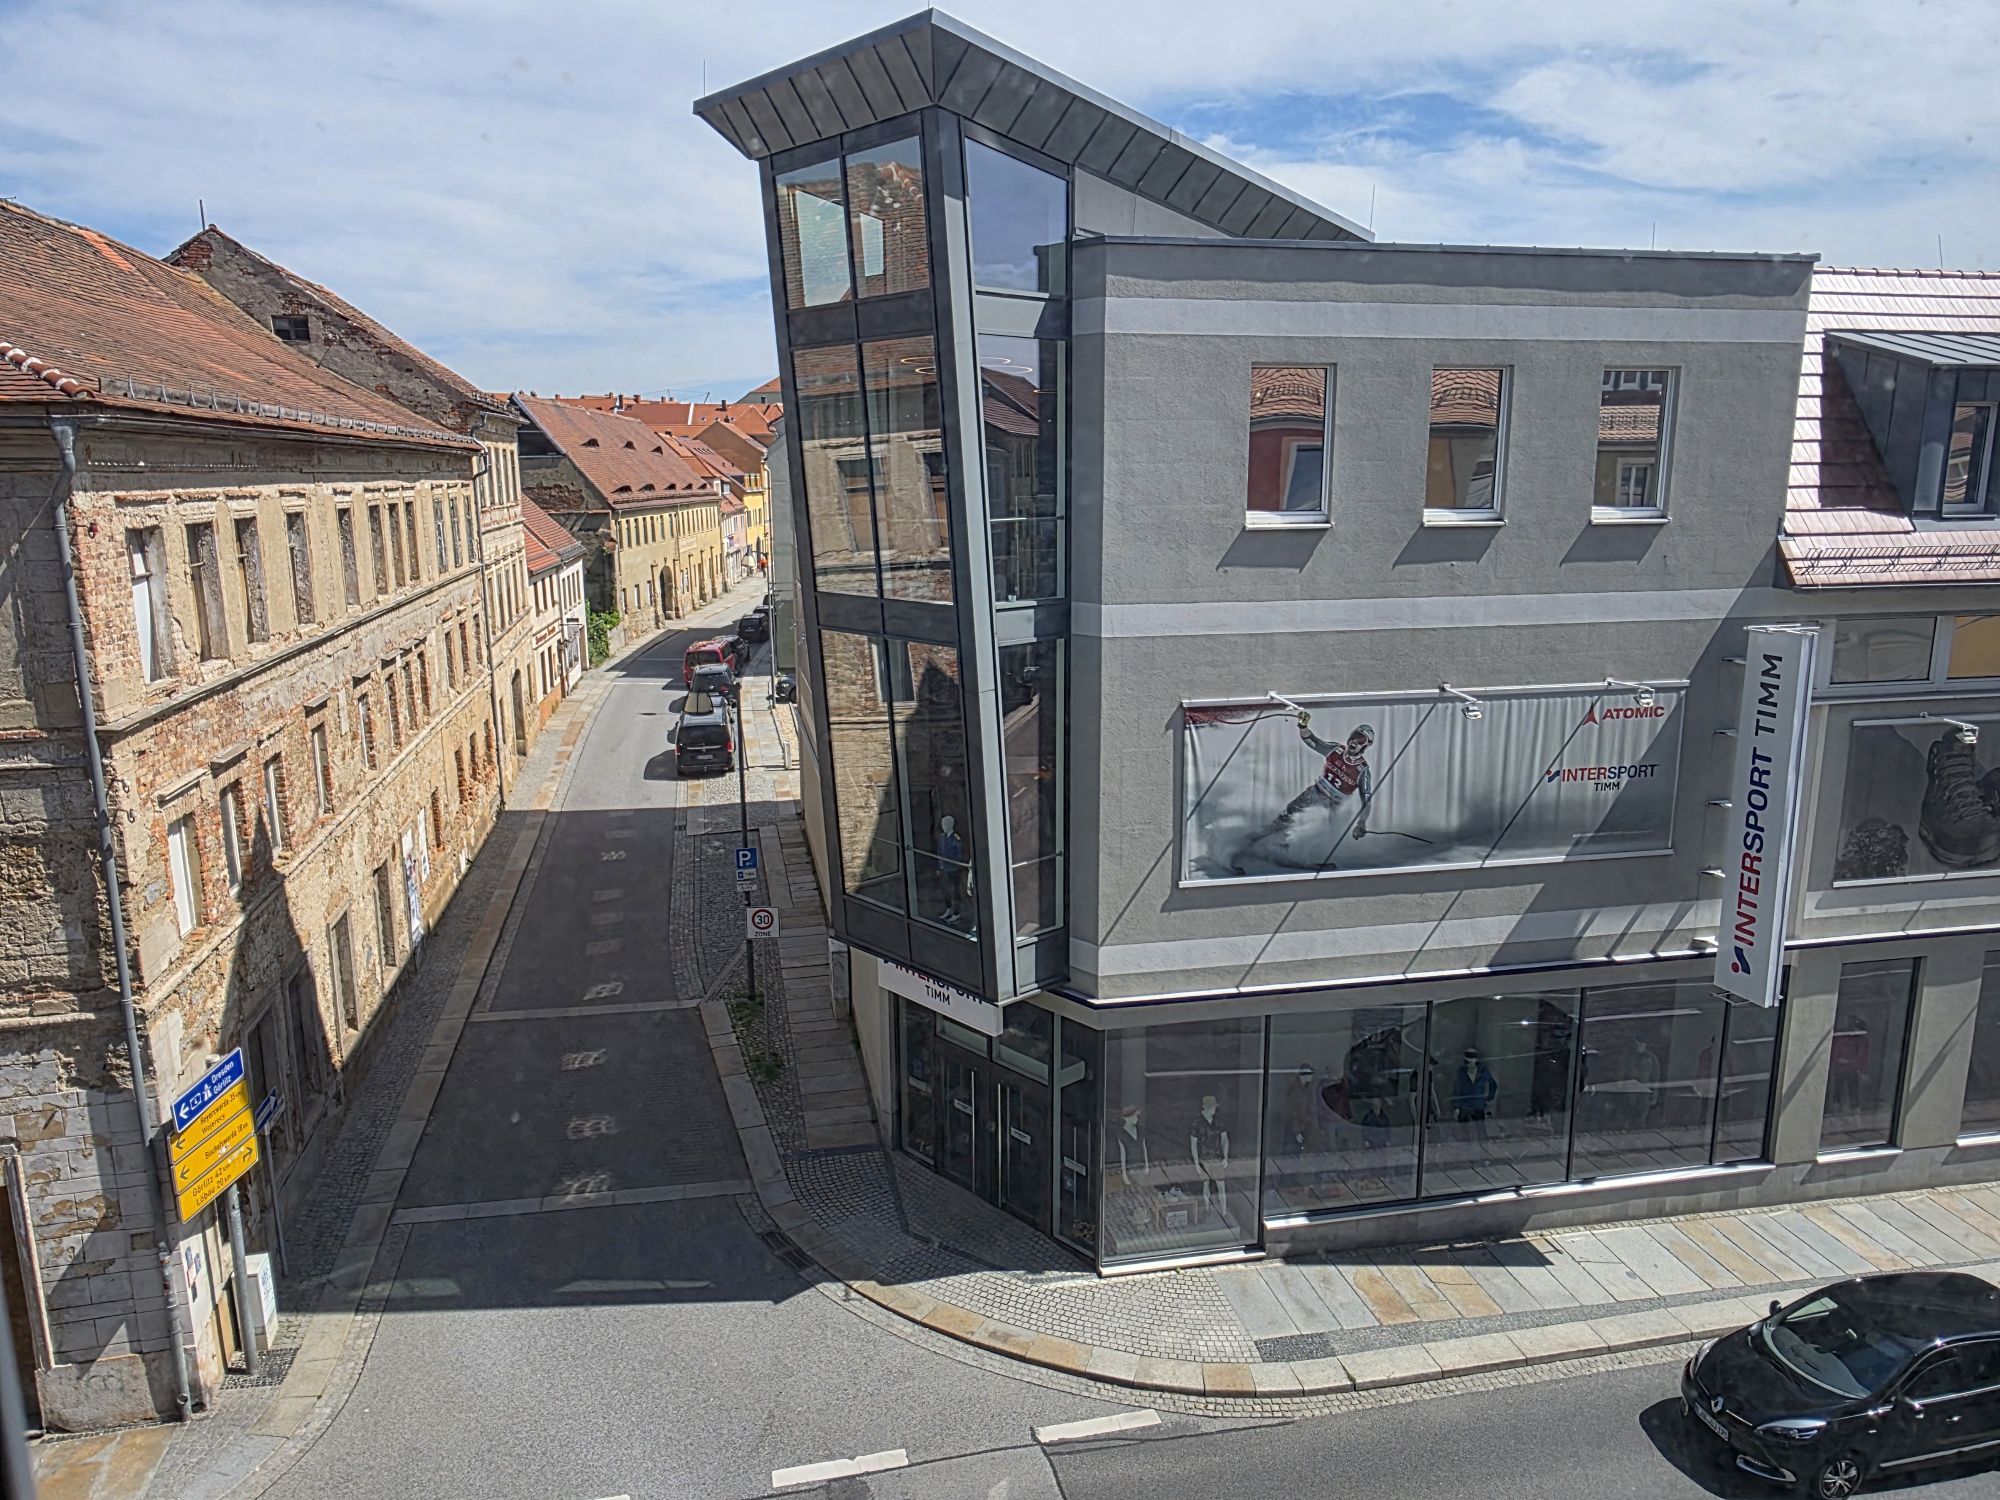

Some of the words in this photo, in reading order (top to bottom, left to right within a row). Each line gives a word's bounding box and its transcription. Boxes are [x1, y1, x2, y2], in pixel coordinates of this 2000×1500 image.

[1602, 706, 1665, 720] ATOMIC
[1562, 764, 1660, 782] INTERSPORT
[1594, 782, 1620, 792] TIMM
[1734, 746, 1772, 947] INTERSPORT
[1755, 653, 1783, 737] TIMM
[756, 914, 770, 925] 30
[925, 984, 951, 1006] TIMM
[211, 1061, 234, 1084] Dresden
[213, 1075, 232, 1095] Görlitz
[192, 1175, 214, 1197] Görlitz
[215, 1168, 223, 1178] 42
[196, 1187, 216, 1206] Löbau
[217, 1179, 225, 1189] 20
